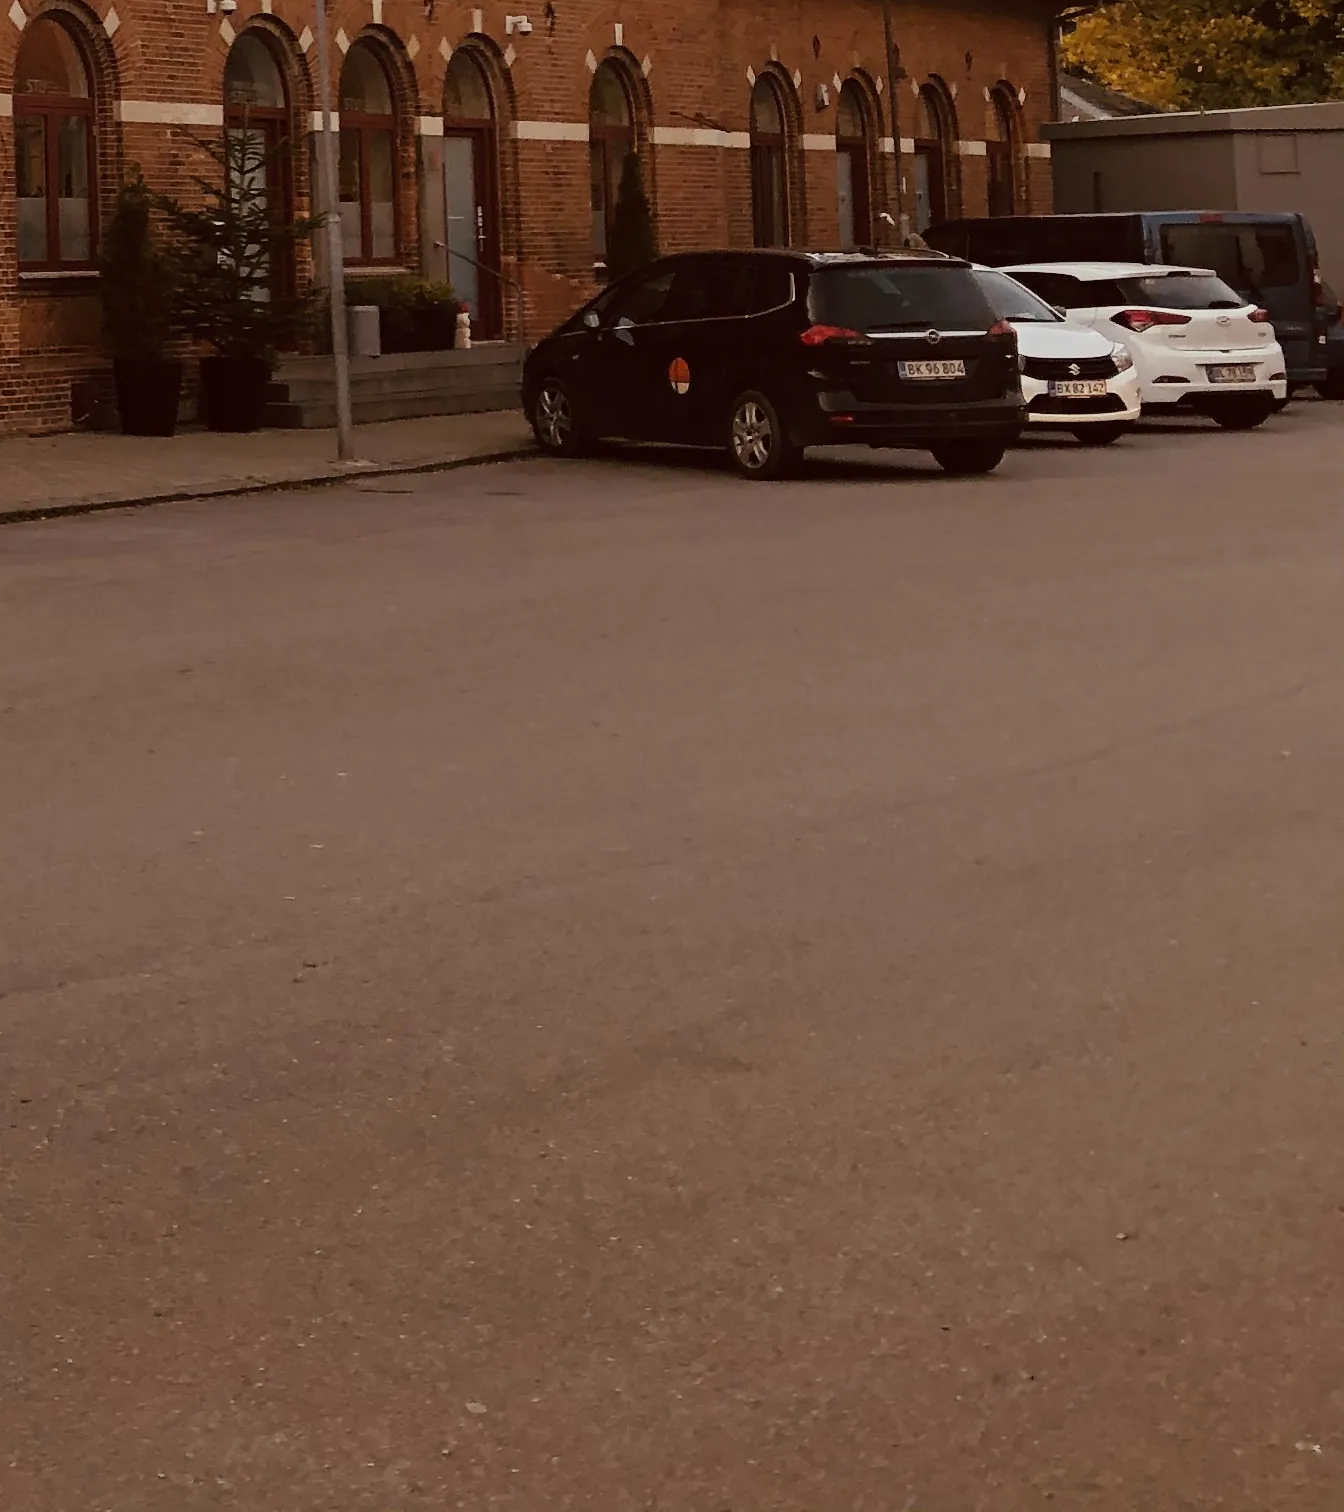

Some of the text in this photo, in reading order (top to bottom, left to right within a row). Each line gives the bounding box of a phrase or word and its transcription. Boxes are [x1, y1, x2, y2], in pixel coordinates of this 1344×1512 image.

[908, 362, 964, 375] BK 96 804
[1072, 383, 1085, 394] 82
